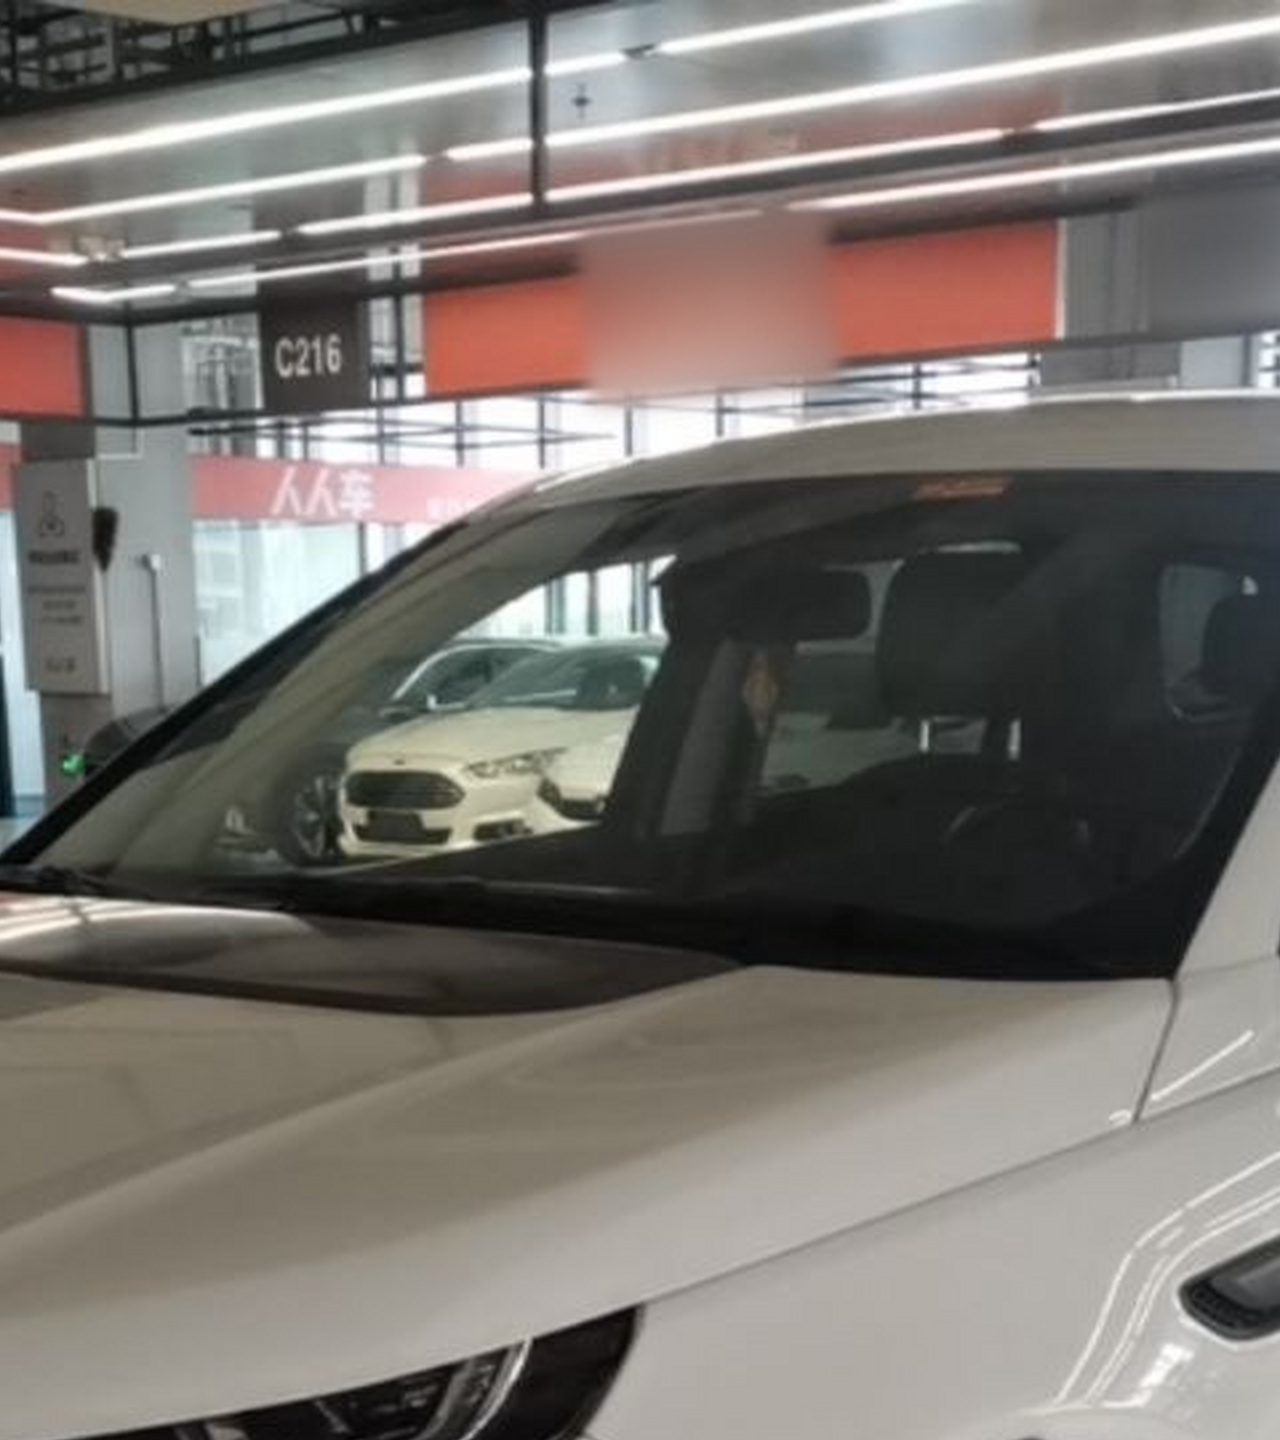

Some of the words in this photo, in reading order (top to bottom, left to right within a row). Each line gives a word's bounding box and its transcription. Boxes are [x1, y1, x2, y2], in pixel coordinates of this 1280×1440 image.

[275, 334, 341, 377] C216
[270, 465, 374, 519] 人人车
